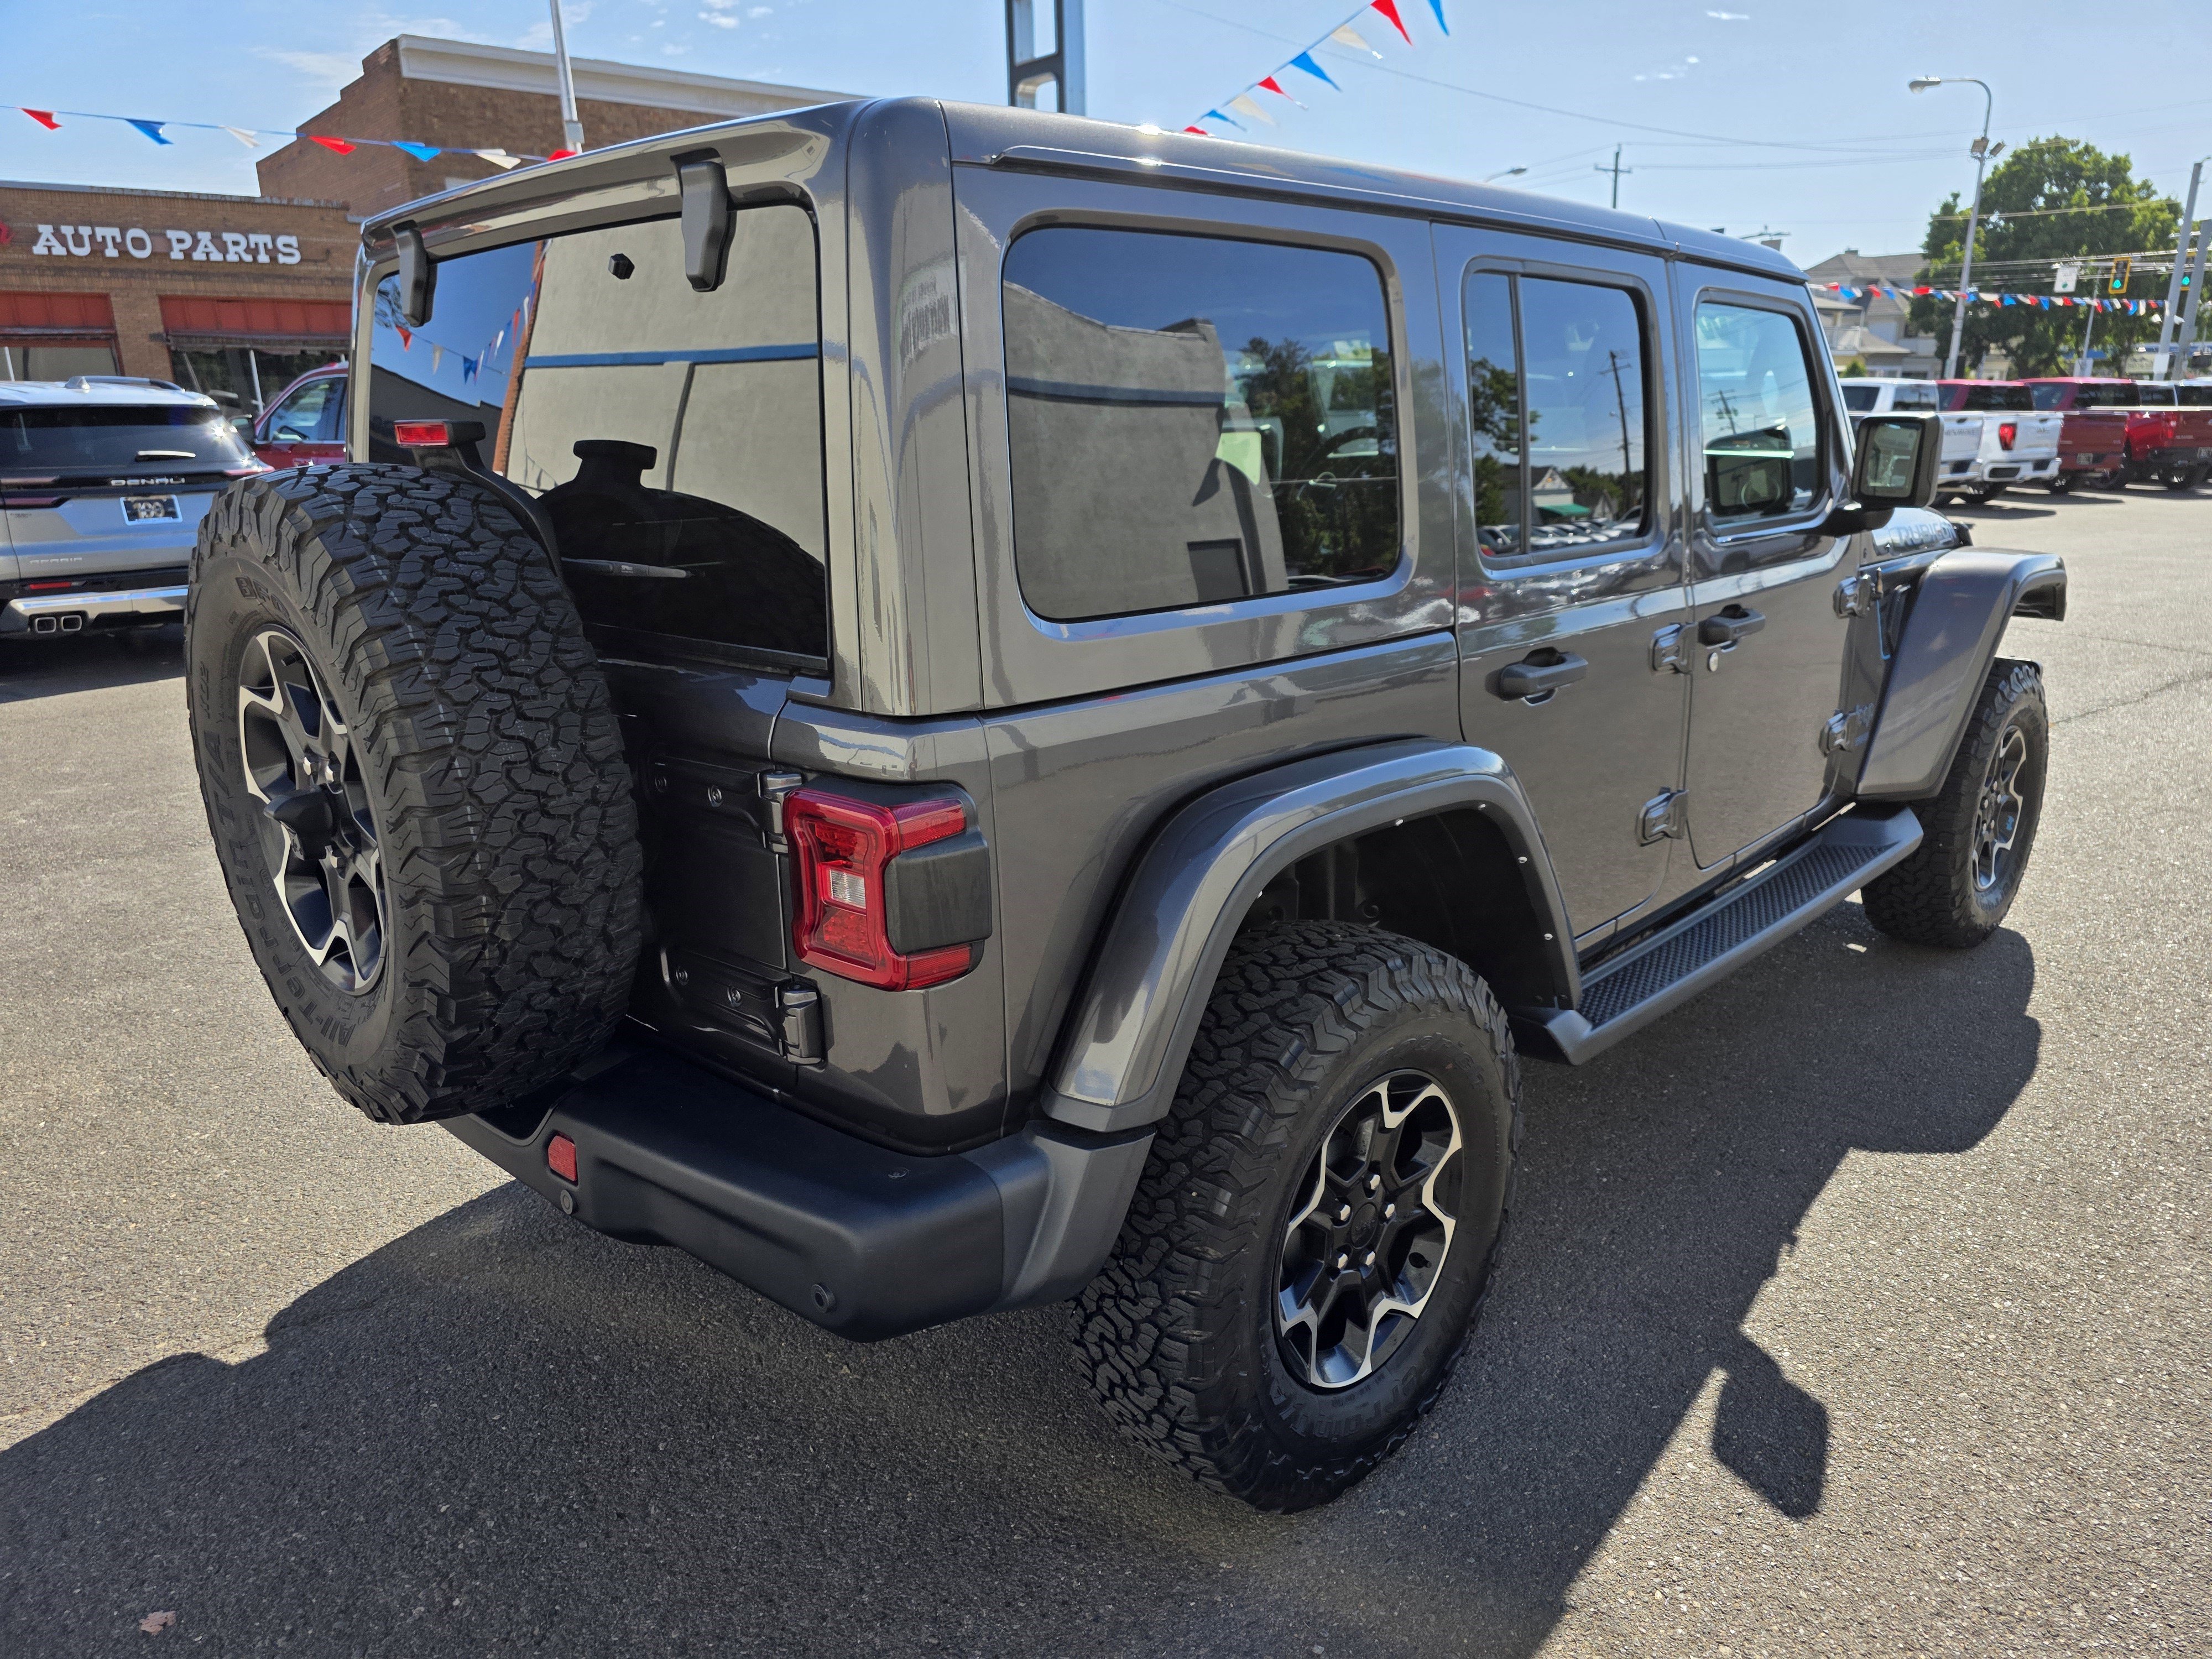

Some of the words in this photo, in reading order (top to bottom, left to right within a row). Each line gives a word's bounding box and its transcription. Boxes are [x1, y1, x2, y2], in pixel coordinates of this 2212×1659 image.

[32, 224, 152, 259] AUTO
[166, 229, 302, 265] PARTS
[111, 477, 185, 486] DENALI
[227, 834, 356, 1049] All-Terrain
